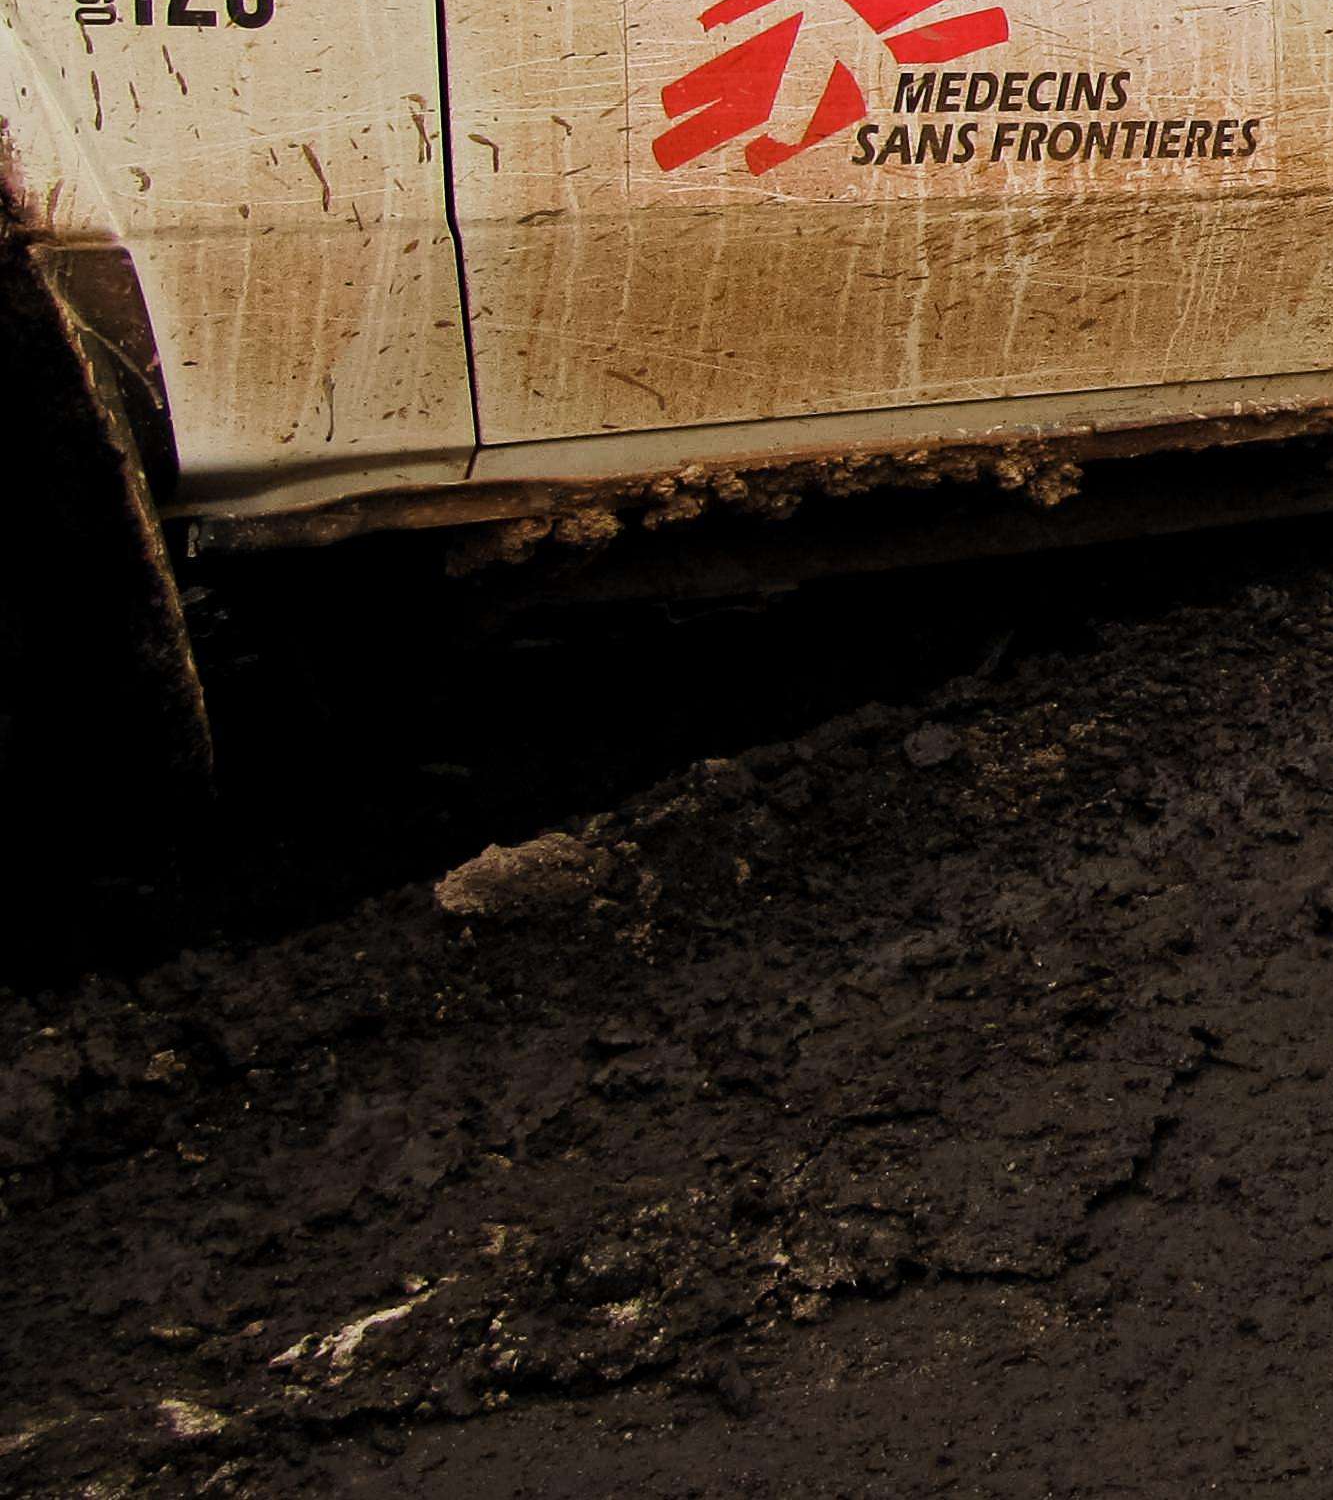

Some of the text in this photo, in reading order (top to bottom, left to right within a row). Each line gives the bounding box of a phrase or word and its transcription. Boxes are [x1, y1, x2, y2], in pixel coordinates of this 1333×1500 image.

[893, 71, 1131, 113] MEDECINS
[851, 118, 1260, 165] SANS FRONTIERES
